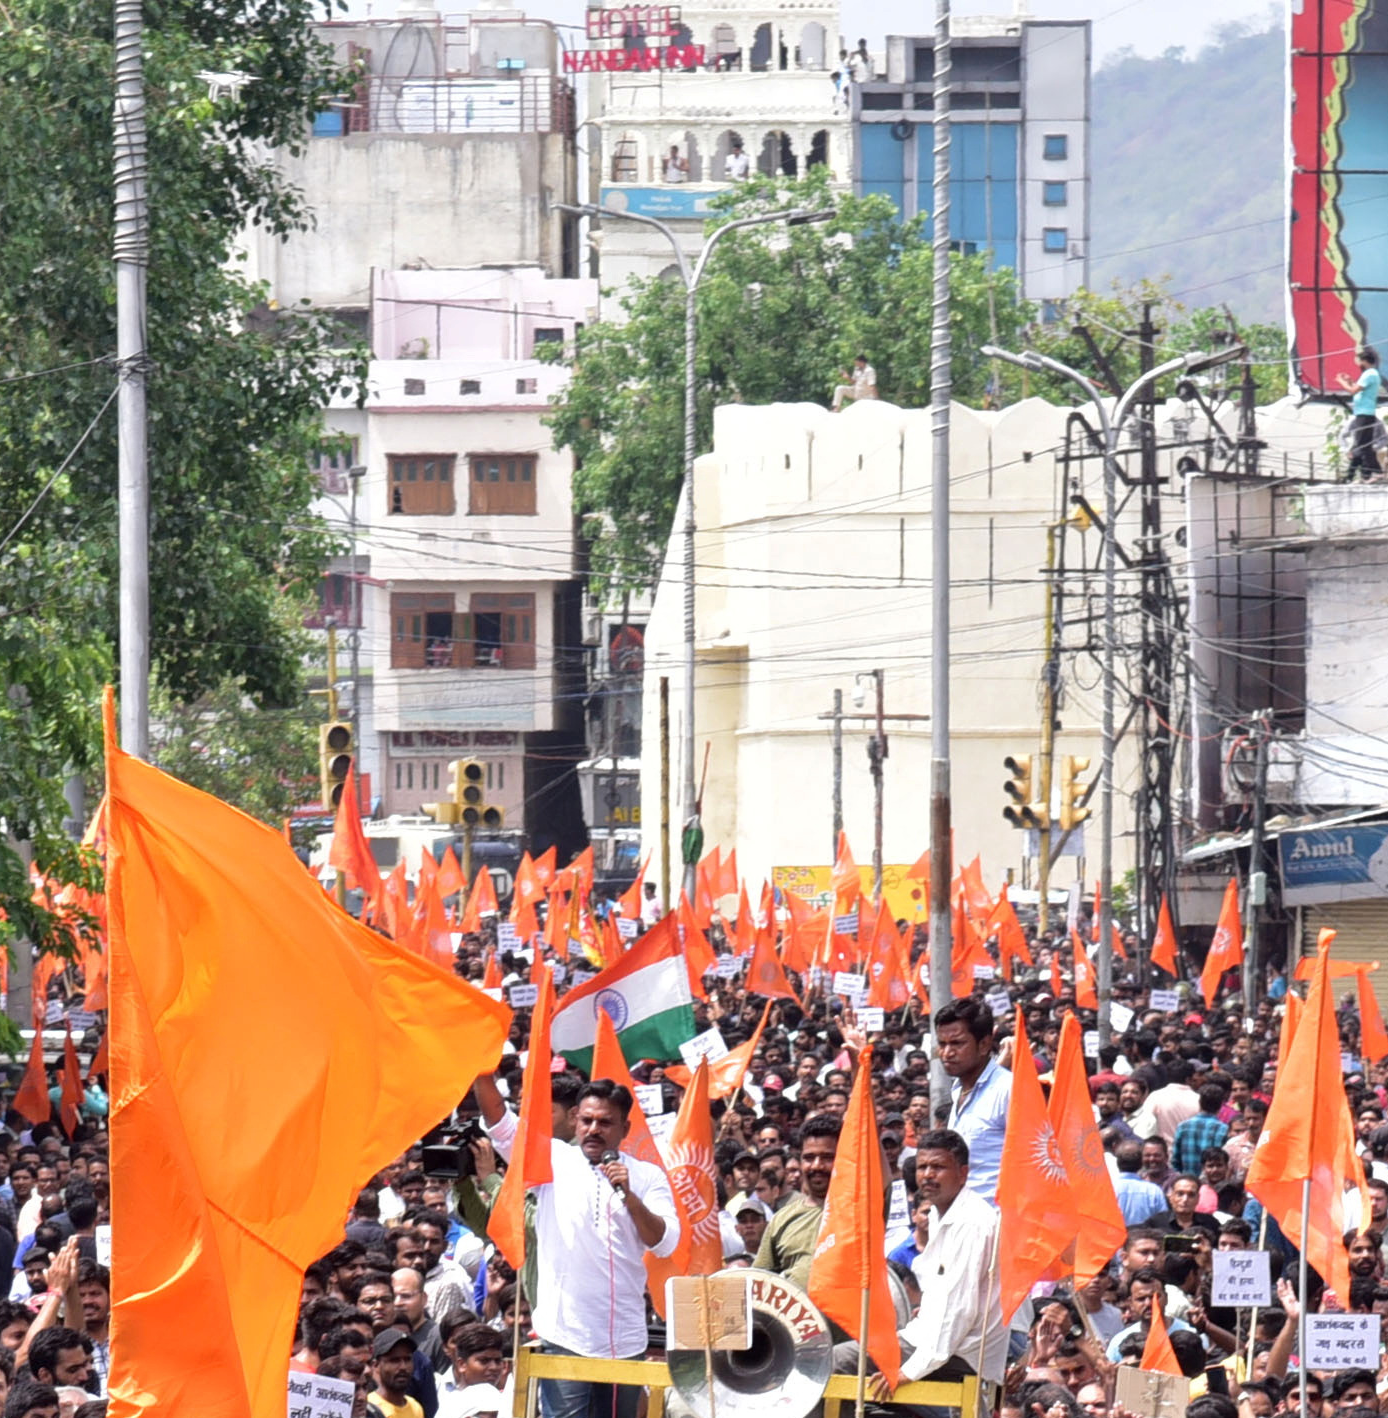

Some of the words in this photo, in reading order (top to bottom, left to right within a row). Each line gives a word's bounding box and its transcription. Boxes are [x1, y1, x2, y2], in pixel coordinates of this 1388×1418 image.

[586, 6, 680, 38] HOTEL
[563, 47, 660, 73] NANDAN
[665, 44, 705, 70] INN
[1289, 834, 1356, 860] Amul
[751, 1279, 822, 1342] ARIYA
